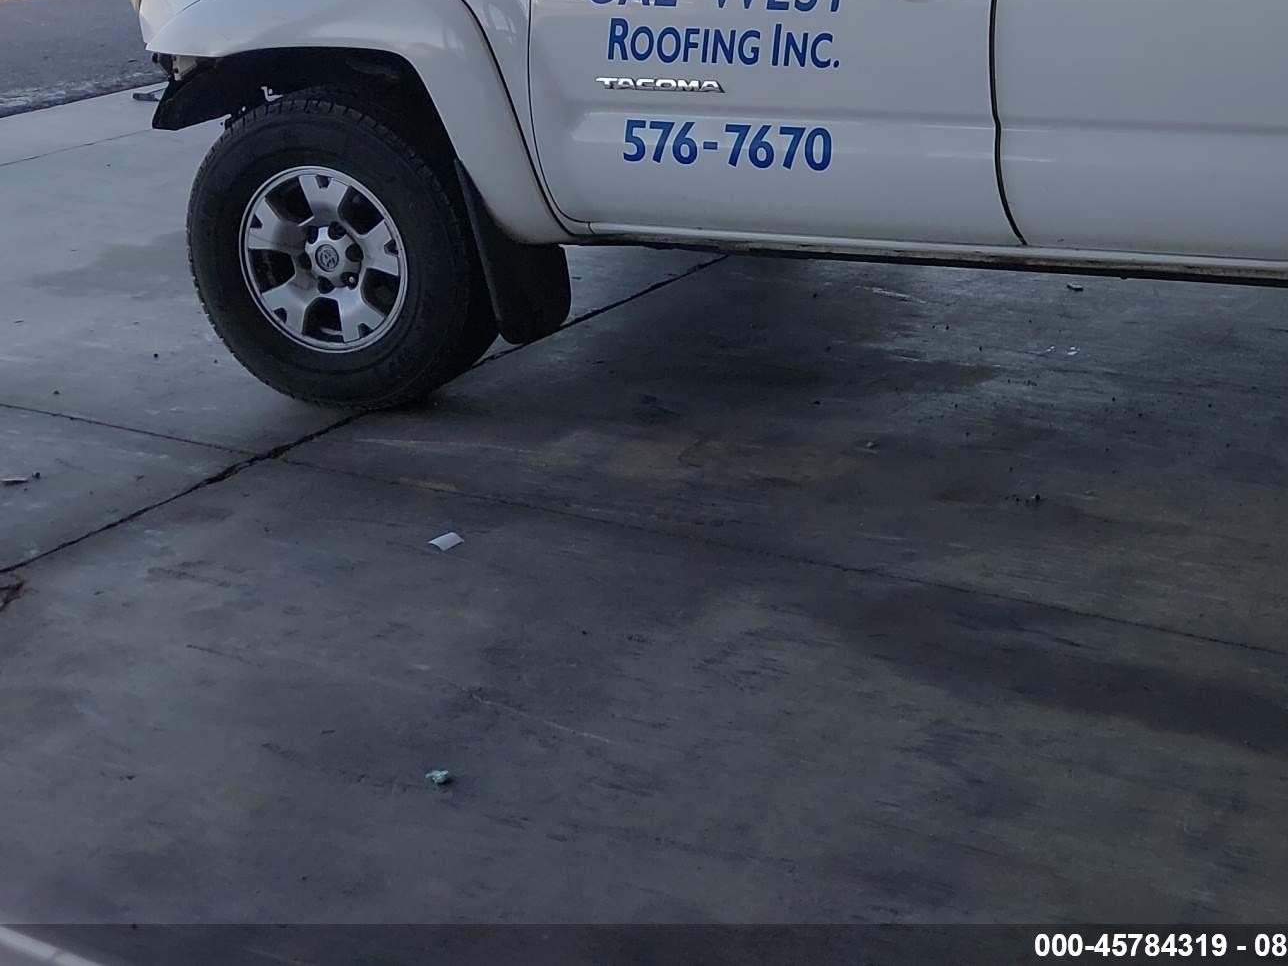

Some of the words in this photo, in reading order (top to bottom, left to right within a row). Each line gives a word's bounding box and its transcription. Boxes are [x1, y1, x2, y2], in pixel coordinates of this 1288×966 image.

[607, 17, 761, 67] ROOFING
[771, 23, 840, 69] INC.
[595, 76, 725, 94] TACOMA
[623, 118, 833, 172] 576-7670
